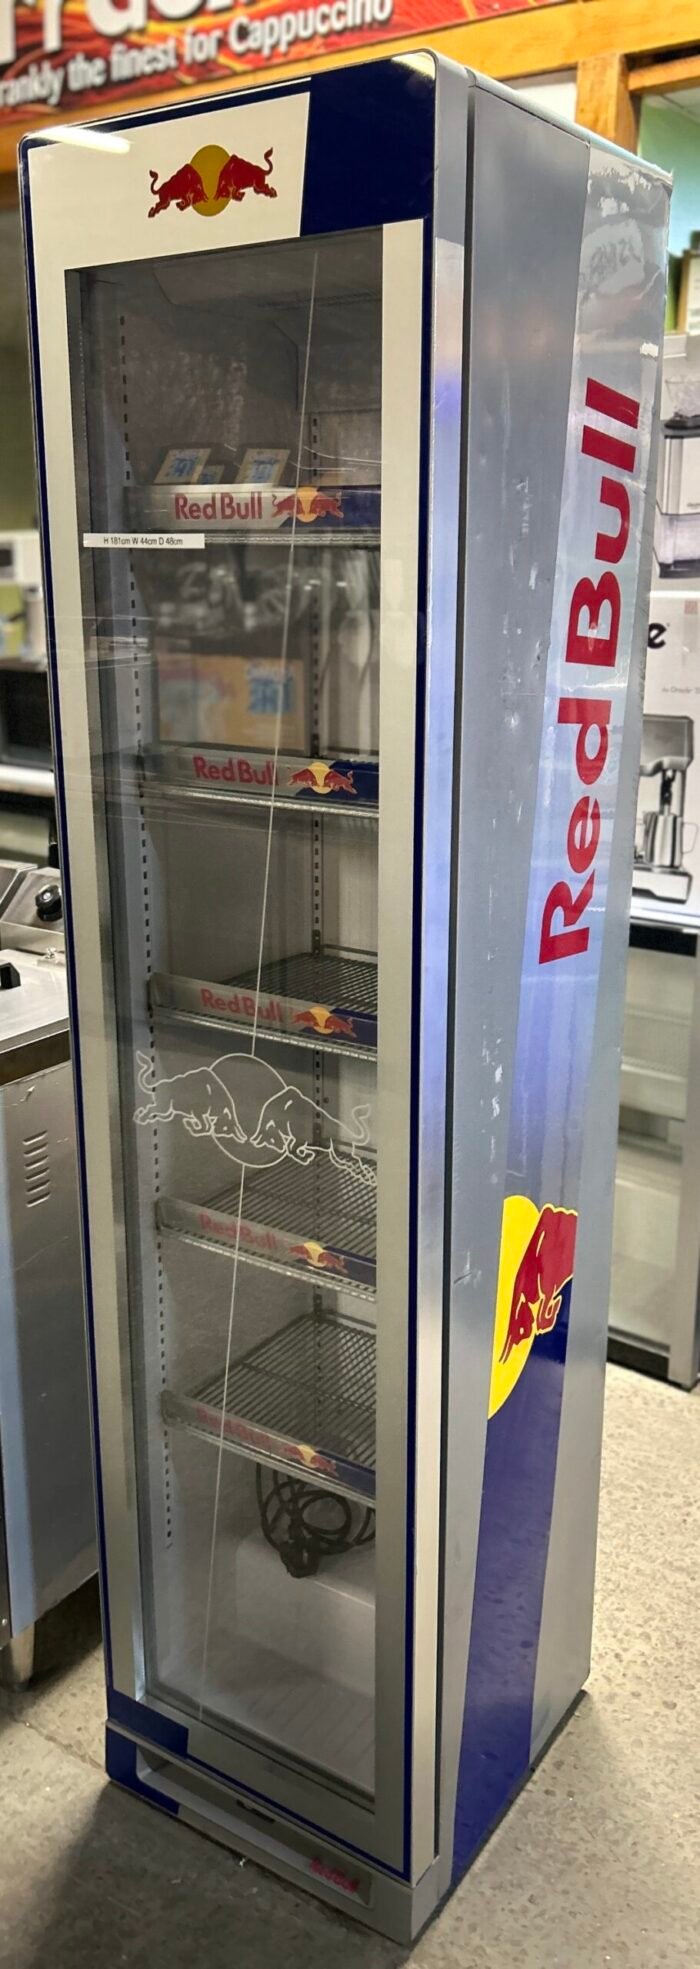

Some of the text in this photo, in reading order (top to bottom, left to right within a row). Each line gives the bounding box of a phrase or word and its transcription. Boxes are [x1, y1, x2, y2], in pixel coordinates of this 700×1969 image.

[68, 52, 106, 91] the
[110, 42, 178, 81] finest
[184, 27, 223, 64] for
[228, 0, 393, 56] Cappuccino
[175, 493, 262, 520] Red Bull
[111, 537, 130, 545] 181cm
[132, 537, 138, 545] W
[140, 537, 157, 545] 44cm
[158, 537, 164, 545] D
[166, 537, 183, 545] 48cm
[541, 378, 639, 962] Red Bull
[193, 756, 278, 786] Red Bull
[200, 988, 284, 1023] Red Bull
